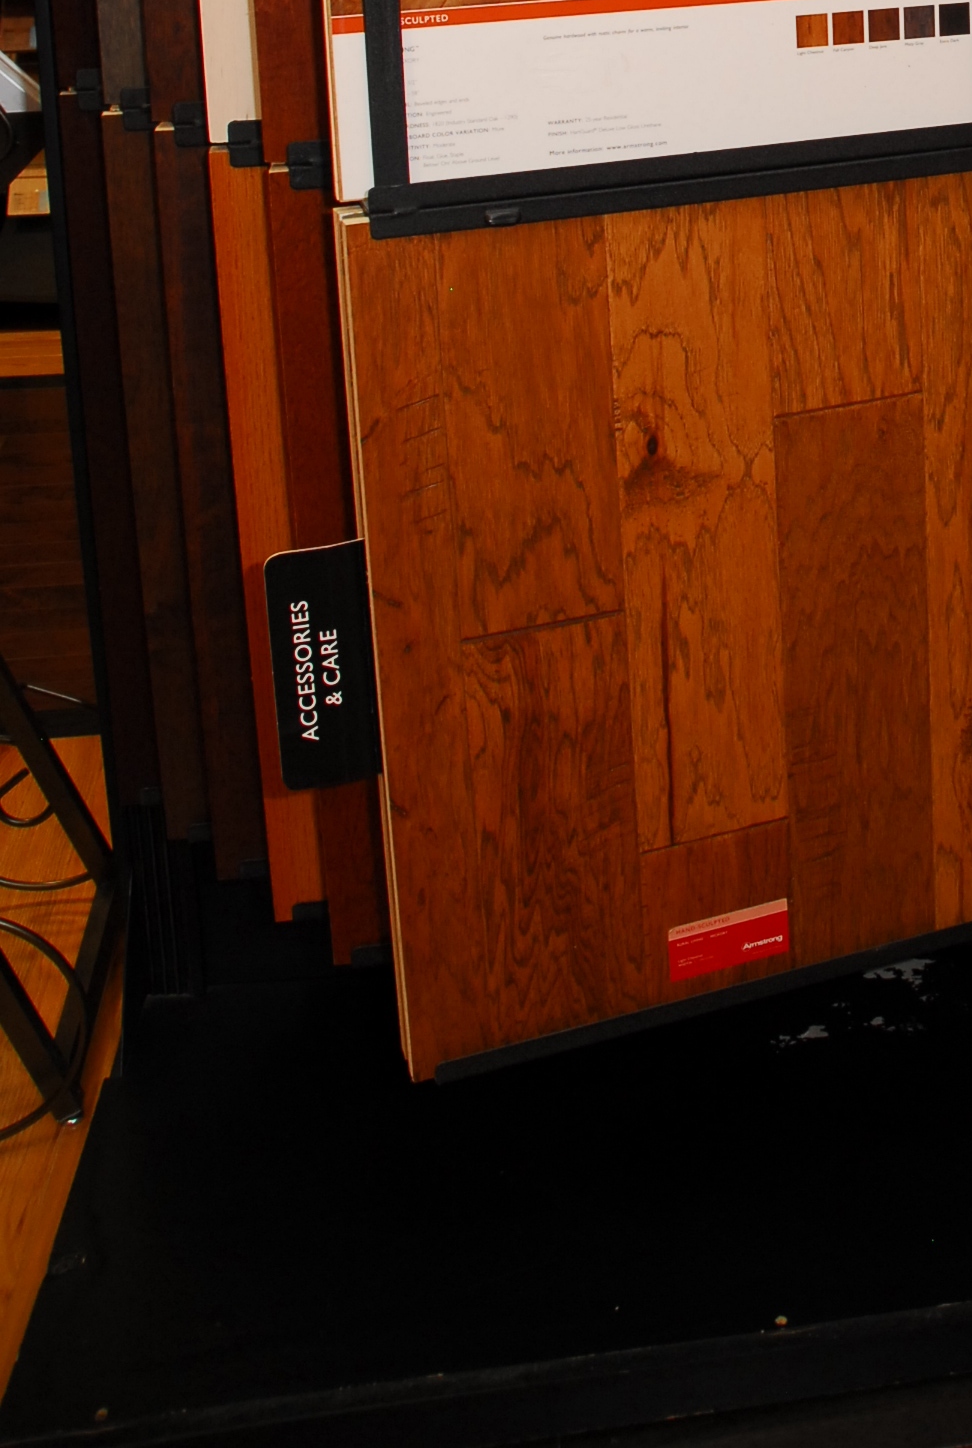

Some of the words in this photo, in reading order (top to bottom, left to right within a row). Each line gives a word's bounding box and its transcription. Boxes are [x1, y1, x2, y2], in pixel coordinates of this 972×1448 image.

[290, 600, 320, 740] ACCESSORIES
[319, 629, 341, 686] CARE
[325, 691, 342, 705] &
[741, 935, 783, 952] Armstrong
